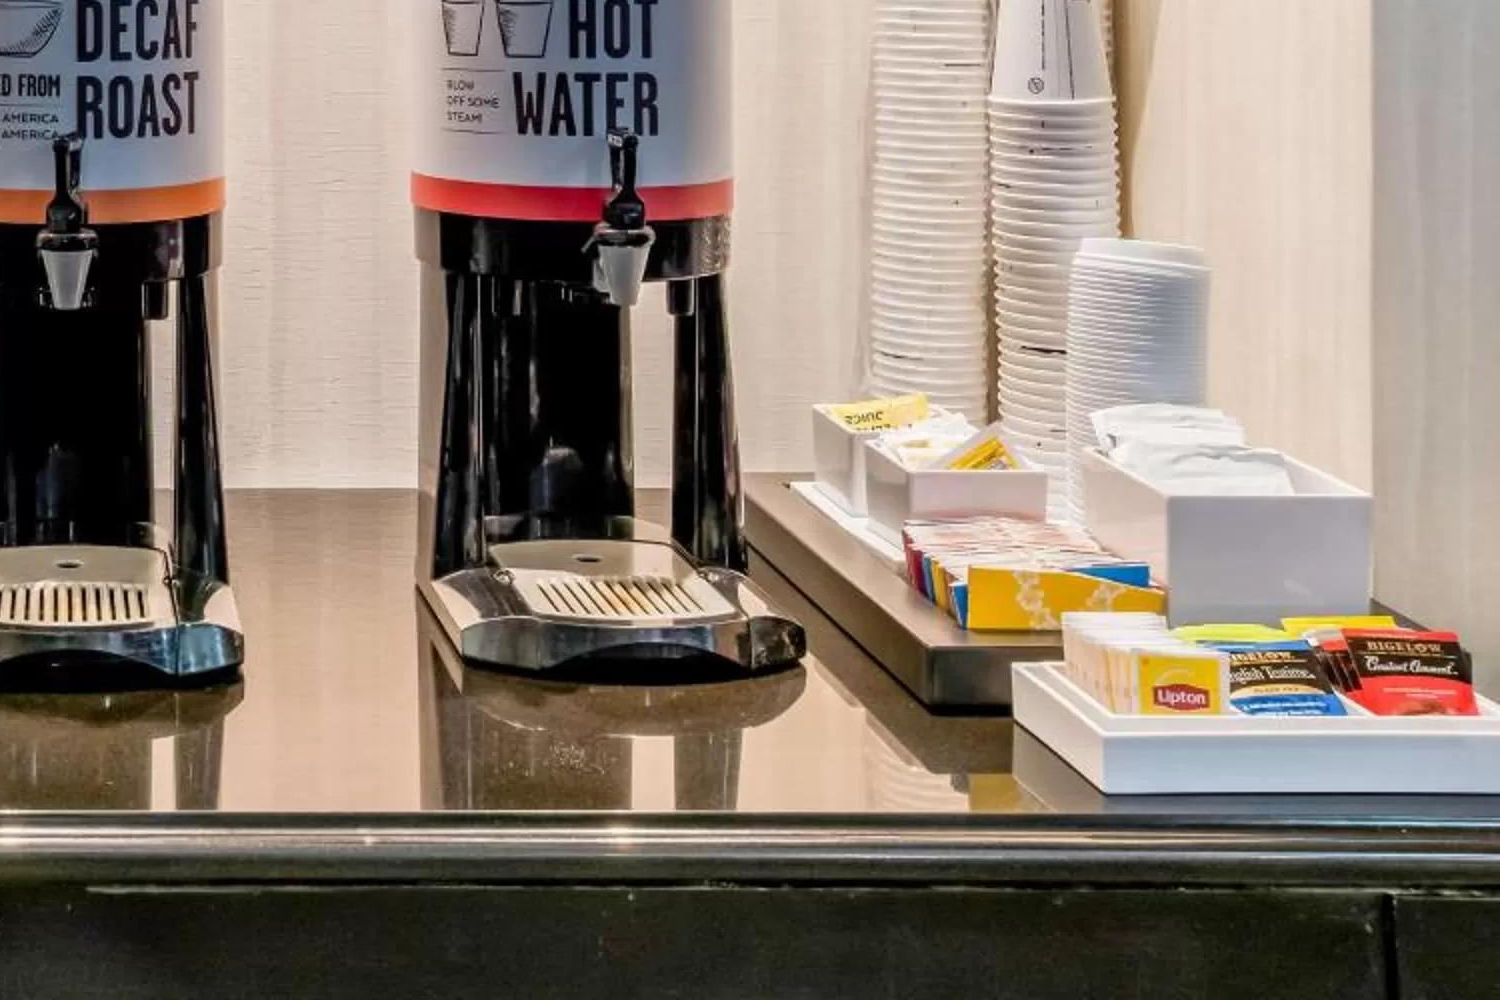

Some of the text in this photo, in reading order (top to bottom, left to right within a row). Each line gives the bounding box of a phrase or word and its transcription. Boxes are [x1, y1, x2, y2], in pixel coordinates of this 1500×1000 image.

[18, 73, 61, 98] FROM
[76, 71, 200, 140] ROAST
[512, 71, 660, 138] WATER
[2, 112, 60, 125] AMERICA
[1, 129, 60, 142] AMERICA
[1367, 641, 1442, 653] BIGELOW
[1156, 688, 1206, 706] Lipton
